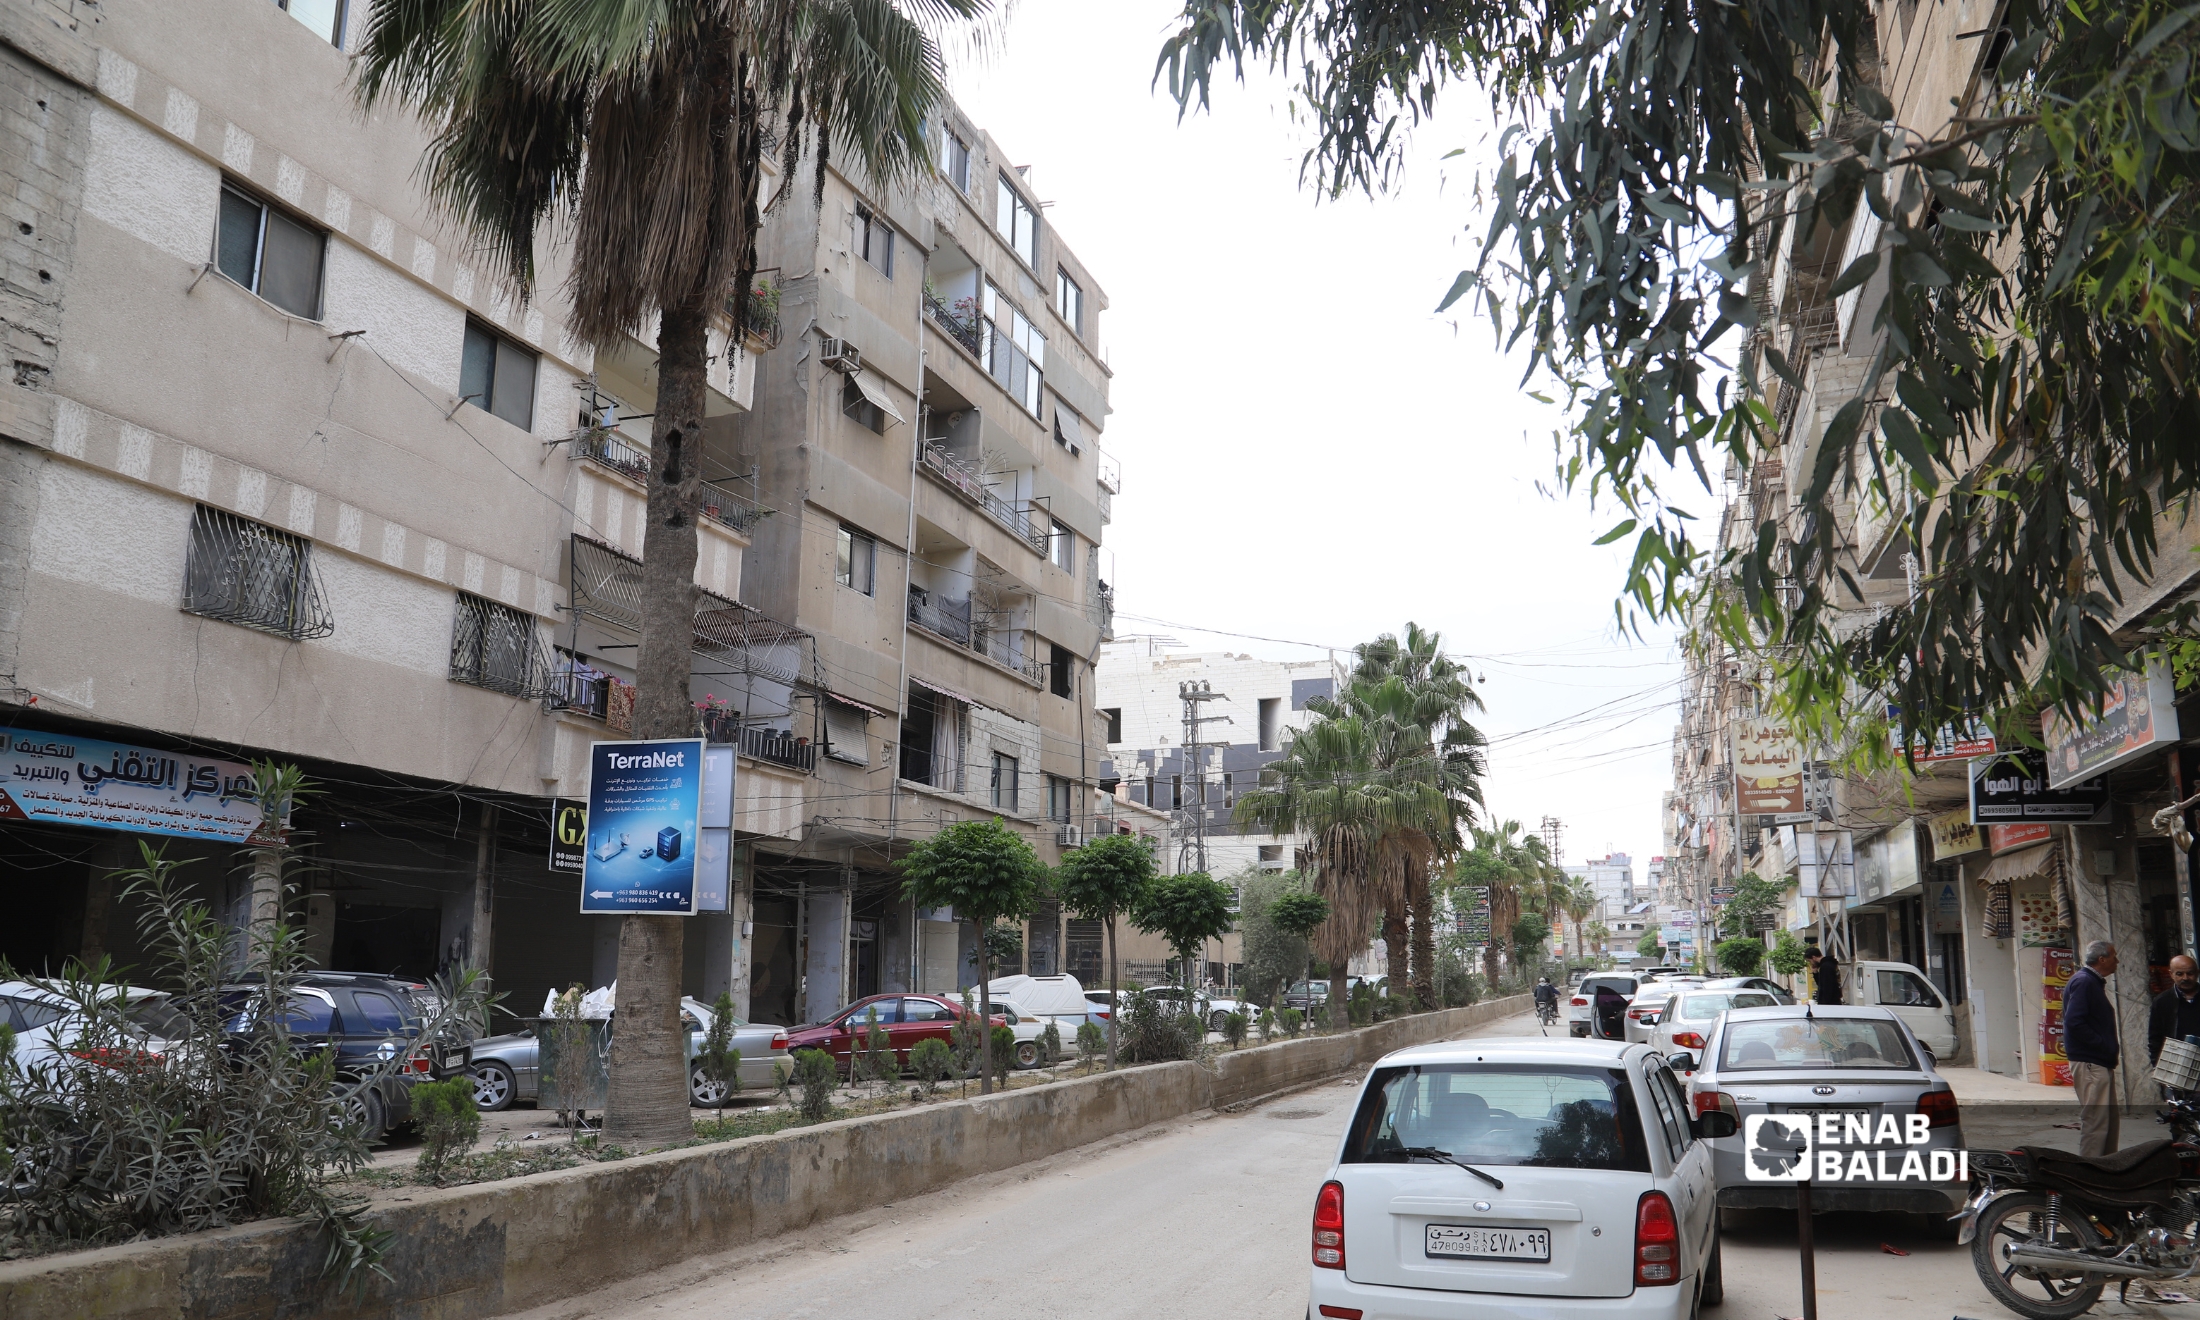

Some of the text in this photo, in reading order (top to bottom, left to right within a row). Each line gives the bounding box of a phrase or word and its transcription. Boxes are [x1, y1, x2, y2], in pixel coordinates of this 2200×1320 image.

[14, 739, 75, 758] للتكييف
[608, 751, 684, 769] TerraNet
[1739, 747, 1796, 769] اليمامة
[13, 764, 69, 785] والتبريد
[78, 751, 260, 803] لمركز التقني
[1984, 777, 2019, 795] الهوا
[2023, 772, 2042, 795] أبو
[22, 789, 50, 800] غسالات
[52, 792, 73, 805] صيانة
[78, 795, 103, 808] والمنزلية
[105, 799, 133, 810] الصناعية
[30, 805, 64, 817] والمستعمل
[65, 810, 88, 820] الجديد
[160, 805, 185, 817] المكيفات
[199, 812, 213, 821] جميع
[148, 818, 163, 828] جميع
[214, 814, 236, 825] وتركيب
[236, 815, 252, 826] صيانة
[181, 824, 190, 832] بيع
[193, 823, 217, 833] مكيفات
[1816, 1087, 1833, 1095] KIA
[1431, 1241, 1471, 1252] 478099
[1490, 1233, 1546, 1254] ٤٧٨٠٩٩
